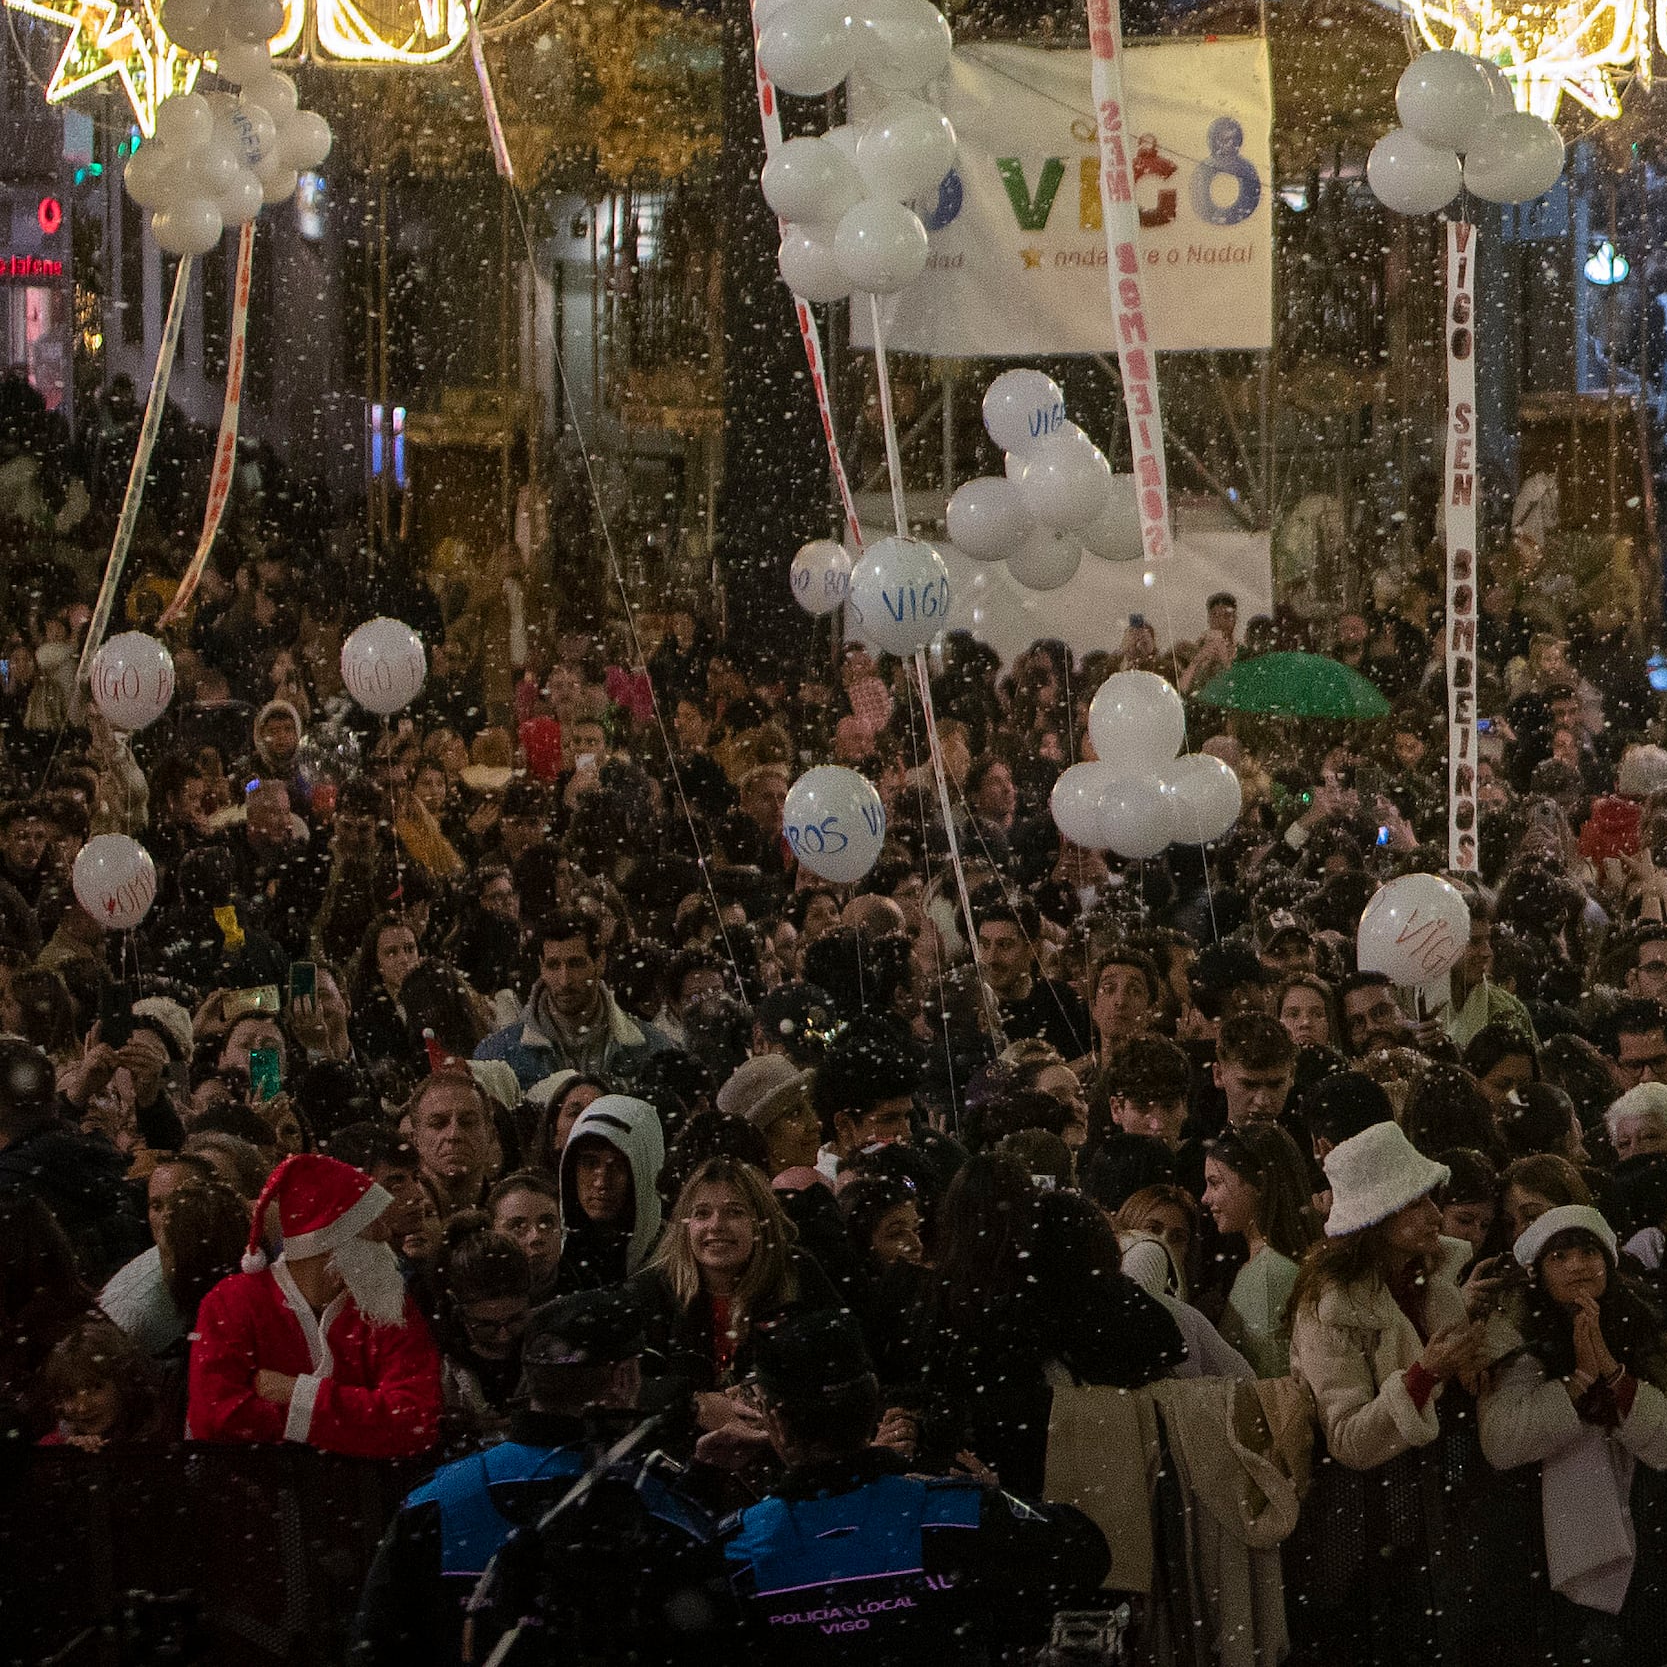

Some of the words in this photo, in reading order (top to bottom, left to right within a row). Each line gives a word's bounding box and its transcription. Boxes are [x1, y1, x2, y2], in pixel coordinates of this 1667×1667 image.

[1450, 223, 1473, 361] VIGO
[1451, 402, 1474, 506] SEN
[1450, 548, 1475, 870] BOMBEIROS
[820, 1618, 870, 1635] VIGO
